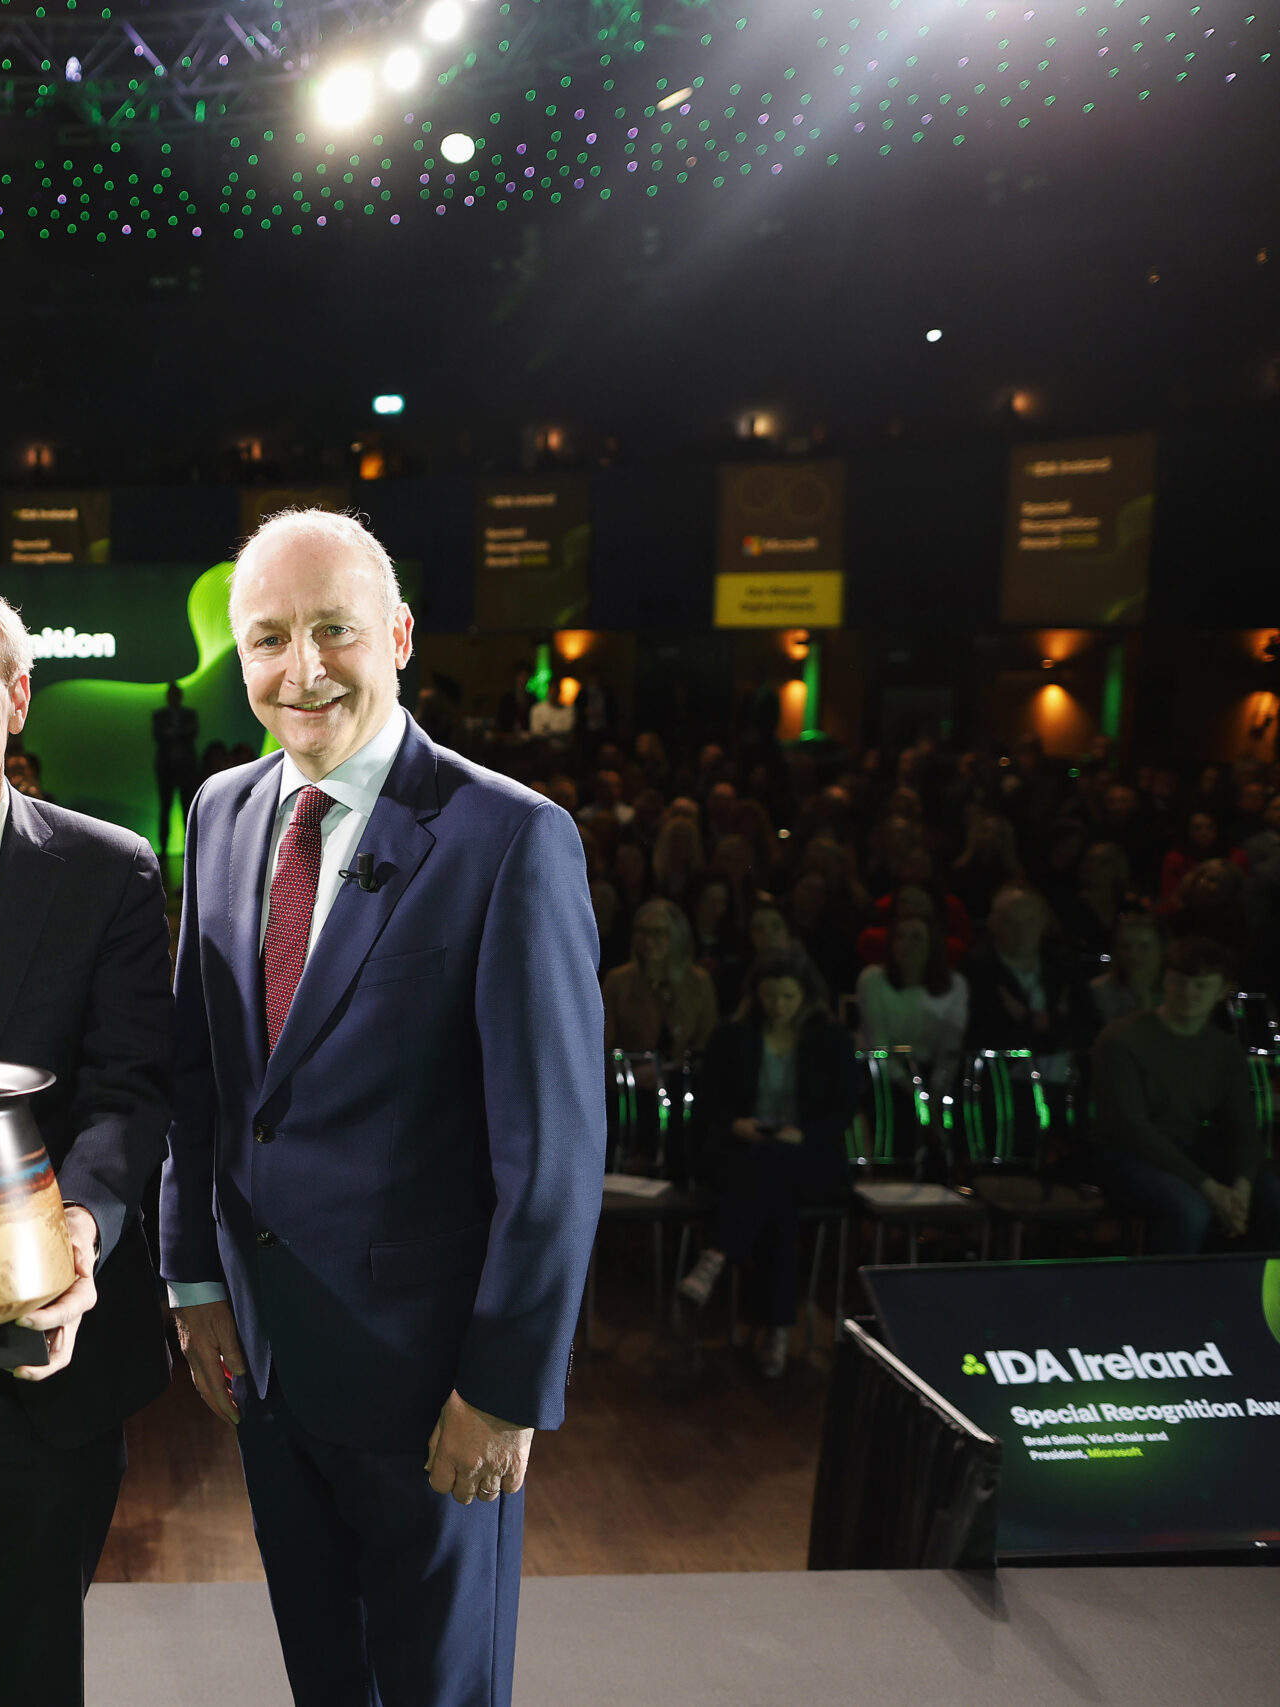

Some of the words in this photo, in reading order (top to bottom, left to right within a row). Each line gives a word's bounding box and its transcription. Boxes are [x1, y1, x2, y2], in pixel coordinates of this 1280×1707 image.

[27, 627, 115, 659] nition
[984, 1348, 1074, 1385] IDA
[1068, 1342, 1233, 1381] Ireland
[1010, 1403, 1101, 1429] Special
[1099, 1399, 1245, 1424] Recognition
[1022, 1435, 1051, 1447] Brad
[1087, 1432, 1114, 1444] Vice
[1113, 1431, 1145, 1443] Chair
[1145, 1431, 1169, 1442] and
[1086, 1447, 1143, 1459] Microsoft
